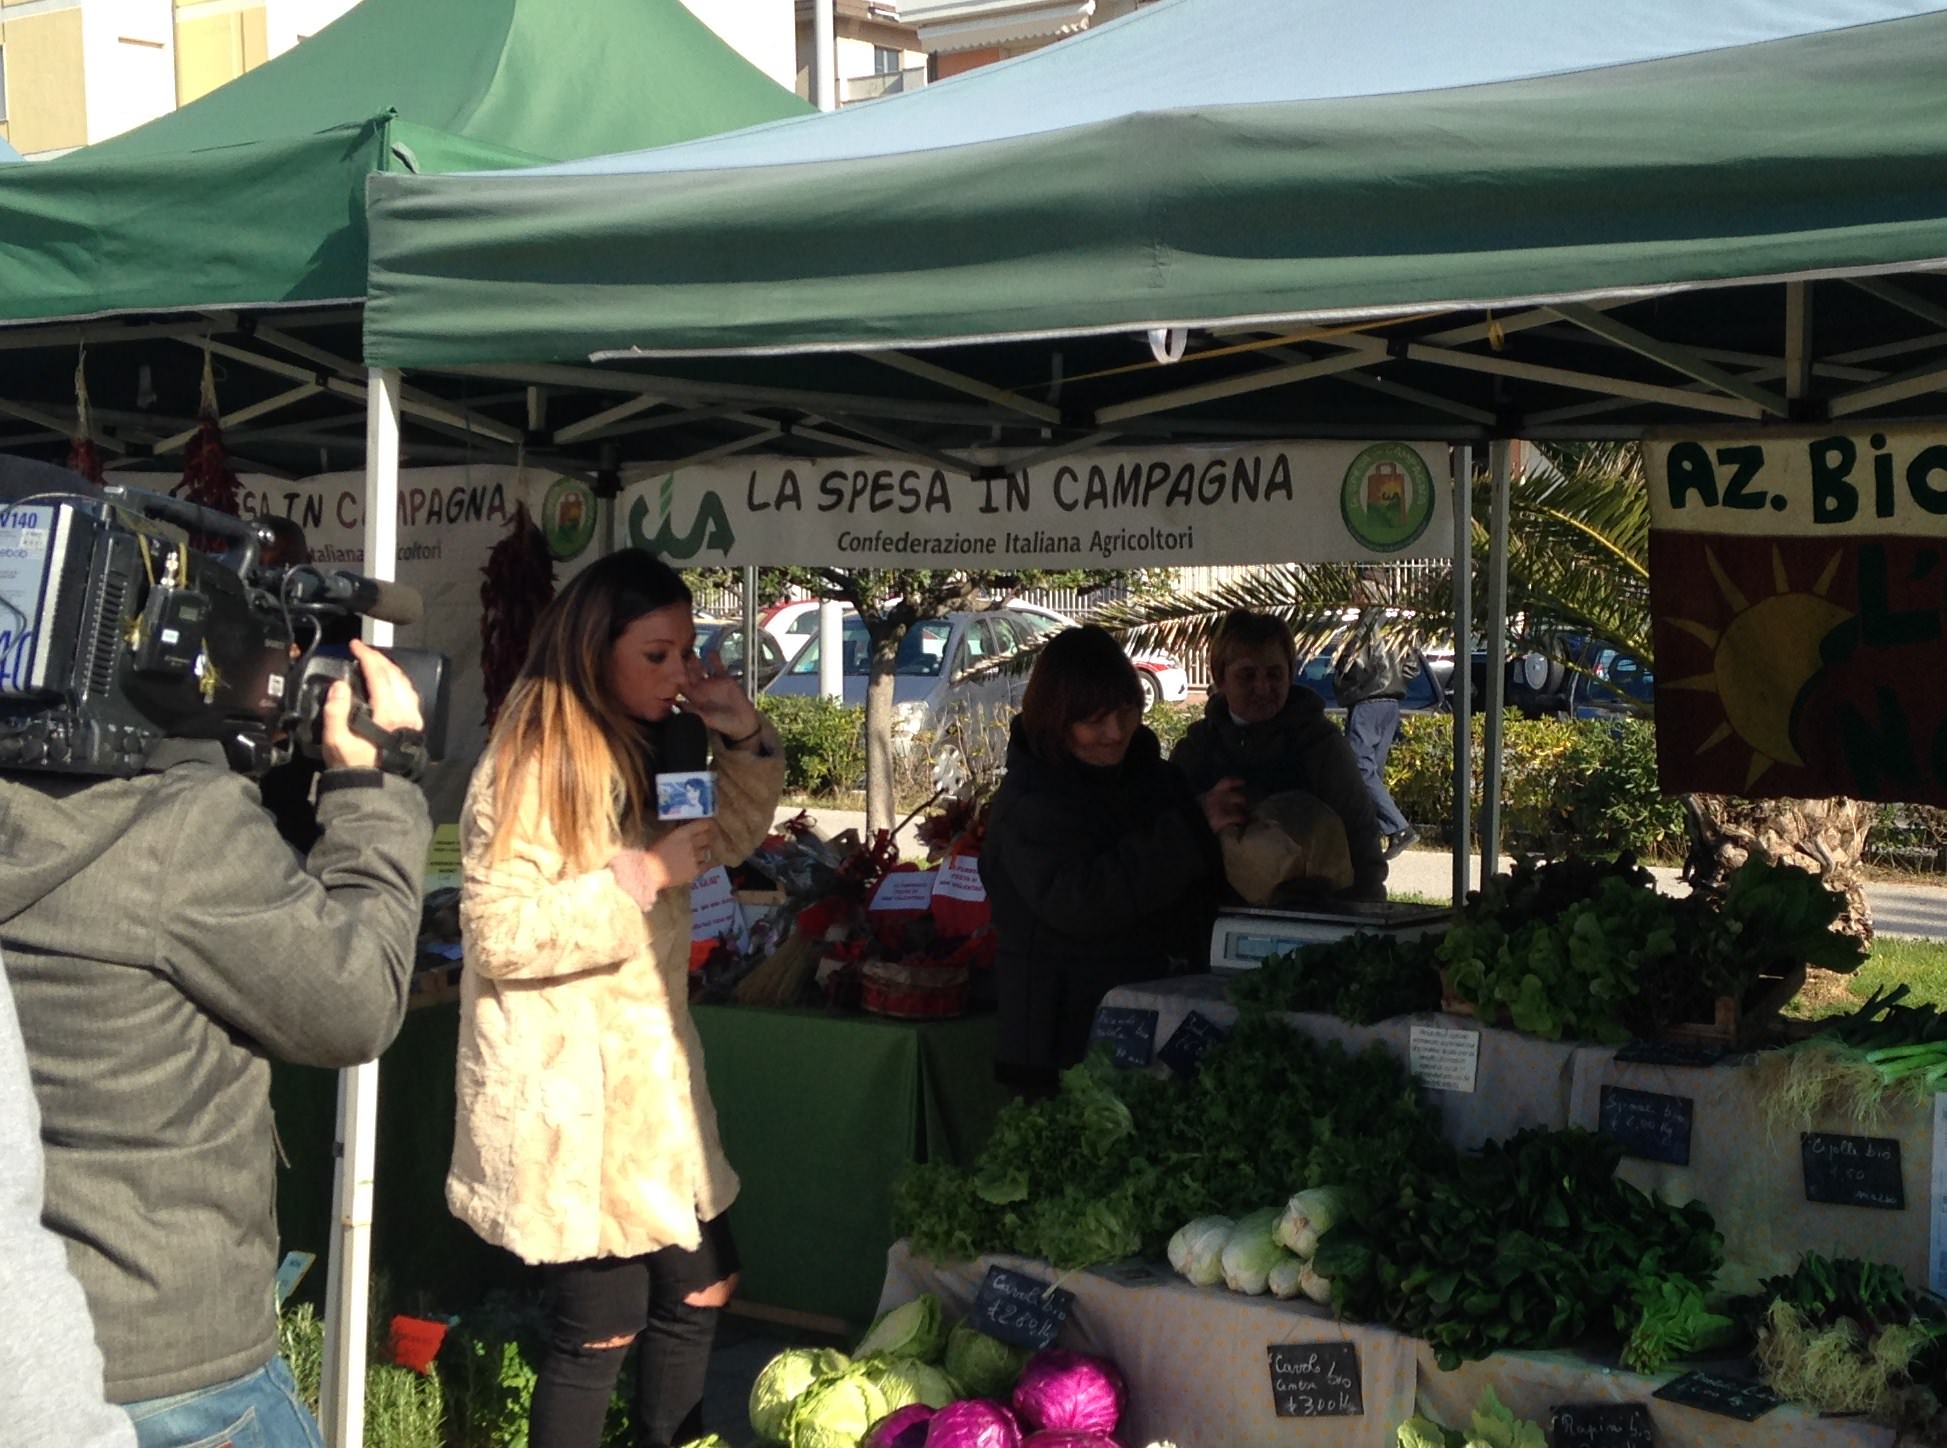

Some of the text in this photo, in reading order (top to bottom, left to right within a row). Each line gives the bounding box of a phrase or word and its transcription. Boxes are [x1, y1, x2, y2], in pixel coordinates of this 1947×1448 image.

[747, 453, 1293, 514] LA SPESA IN CAMPAGNA
[1667, 441, 1787, 511] AZ.
[308, 544, 364, 562] taliana
[837, 525, 1193, 558] Confederazione Italiana Agricoltori
